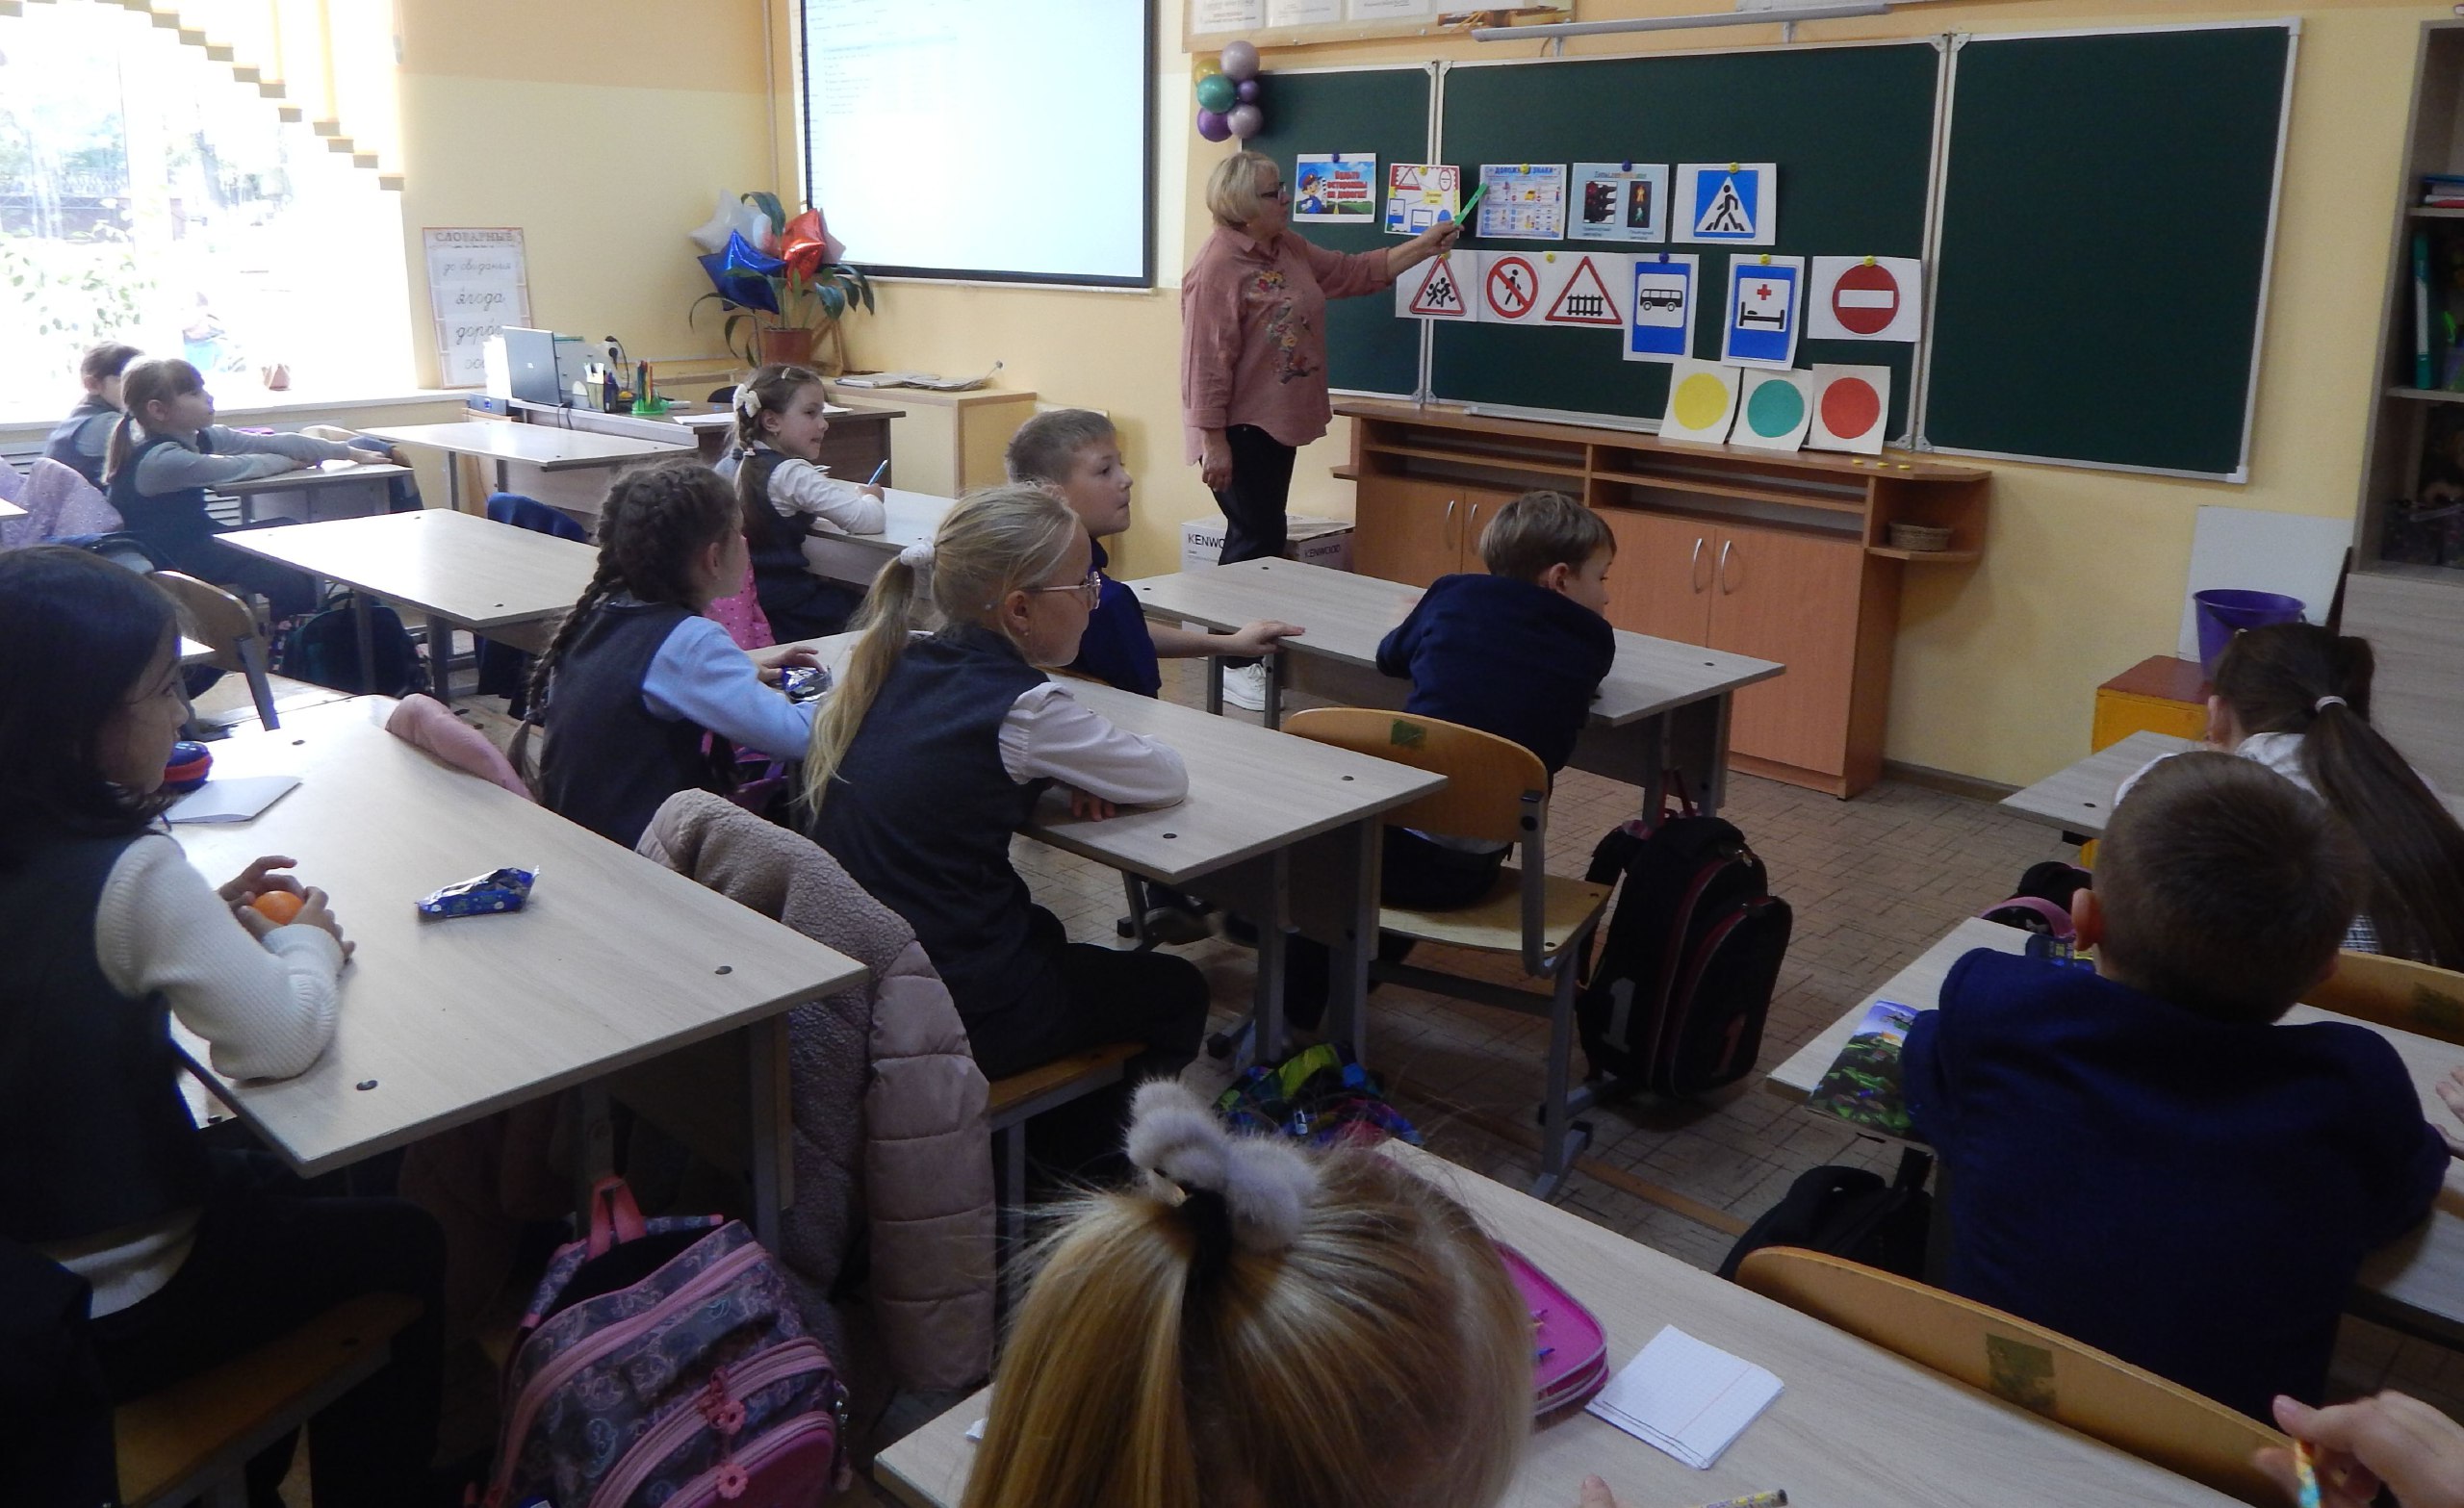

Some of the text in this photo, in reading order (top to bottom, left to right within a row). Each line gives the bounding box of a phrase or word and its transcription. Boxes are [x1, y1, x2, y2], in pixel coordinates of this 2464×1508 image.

[435, 232, 513, 242] СЛОВАРНЫЕ
[1188, 533, 1225, 550] KENWO
[1305, 544, 1341, 558] KENWOOD
